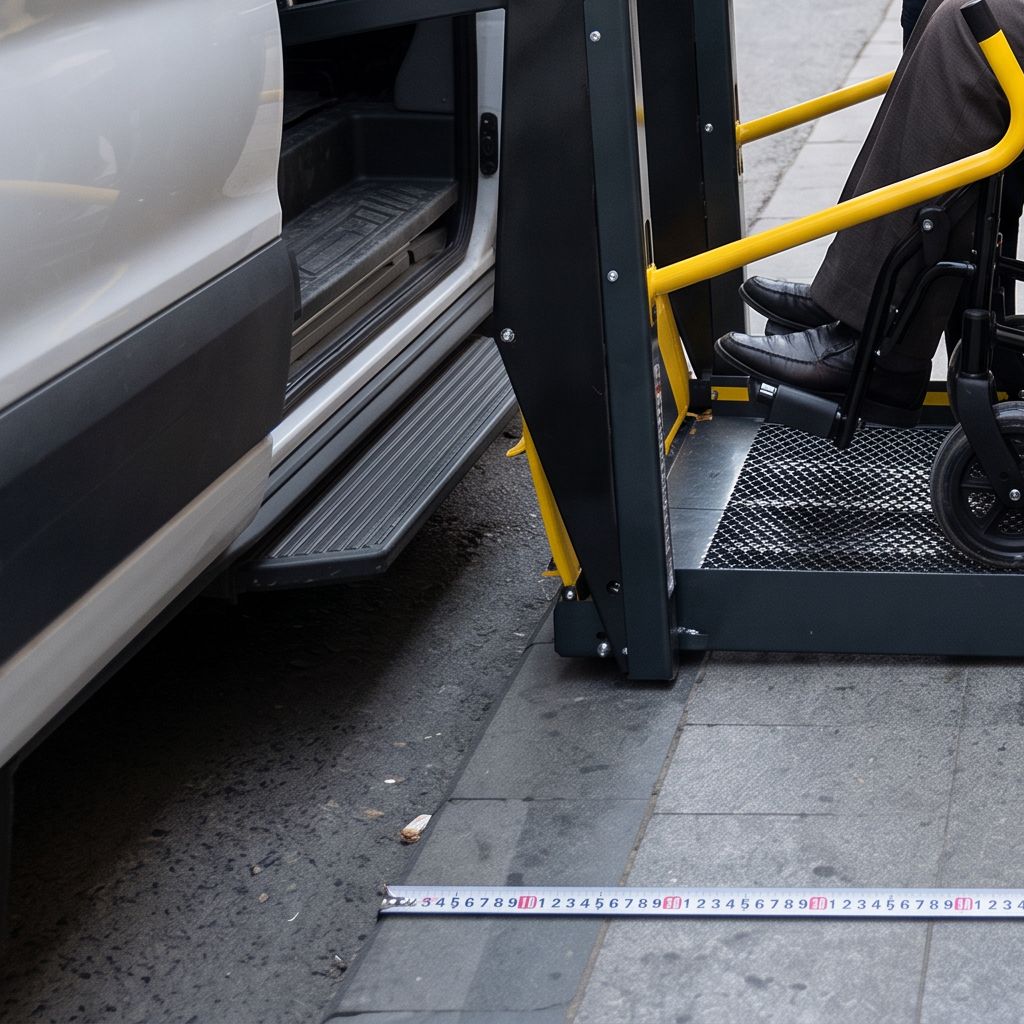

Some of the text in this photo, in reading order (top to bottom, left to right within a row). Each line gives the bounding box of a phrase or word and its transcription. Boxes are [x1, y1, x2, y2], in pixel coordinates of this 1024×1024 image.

[434, 896, 446, 908] 4
[450, 896, 460, 909] 5
[464, 896, 475, 908] 6
[480, 896, 490, 908] 7
[493, 896, 504, 908] 8
[507, 896, 518, 908] 9
[538, 897, 545, 908] 1
[551, 897, 561, 909] 2
[565, 897, 576, 909] 3
[579, 898, 591, 909] 4
[594, 897, 605, 911] 5
[608, 898, 619, 909] 6
[624, 898, 634, 909] 7
[637, 898, 648, 909] 8
[652, 898, 662, 909] 9
[683, 898, 690, 909] 1
[696, 898, 706, 909] 2
[711, 898, 721, 909] 3
[725, 898, 735, 909] 4
[740, 898, 750, 912] 5
[754, 898, 765, 909] 6
[770, 898, 780, 910] 7
[783, 898, 794, 910] 8
[798, 898, 808, 910] 9
[829, 899, 835, 910] 1
[842, 899, 852, 910] 2
[857, 899, 867, 910] 3
[871, 899, 881, 910] 4
[886, 899, 895, 911] 5
[900, 899, 910, 910] 6
[915, 899, 925, 910] 7
[929, 899, 939, 910] 8
[943, 899, 954, 910] 9
[974, 899, 981, 910] 1
[988, 899, 997, 910] 2
[1002, 899, 1012, 911] 3
